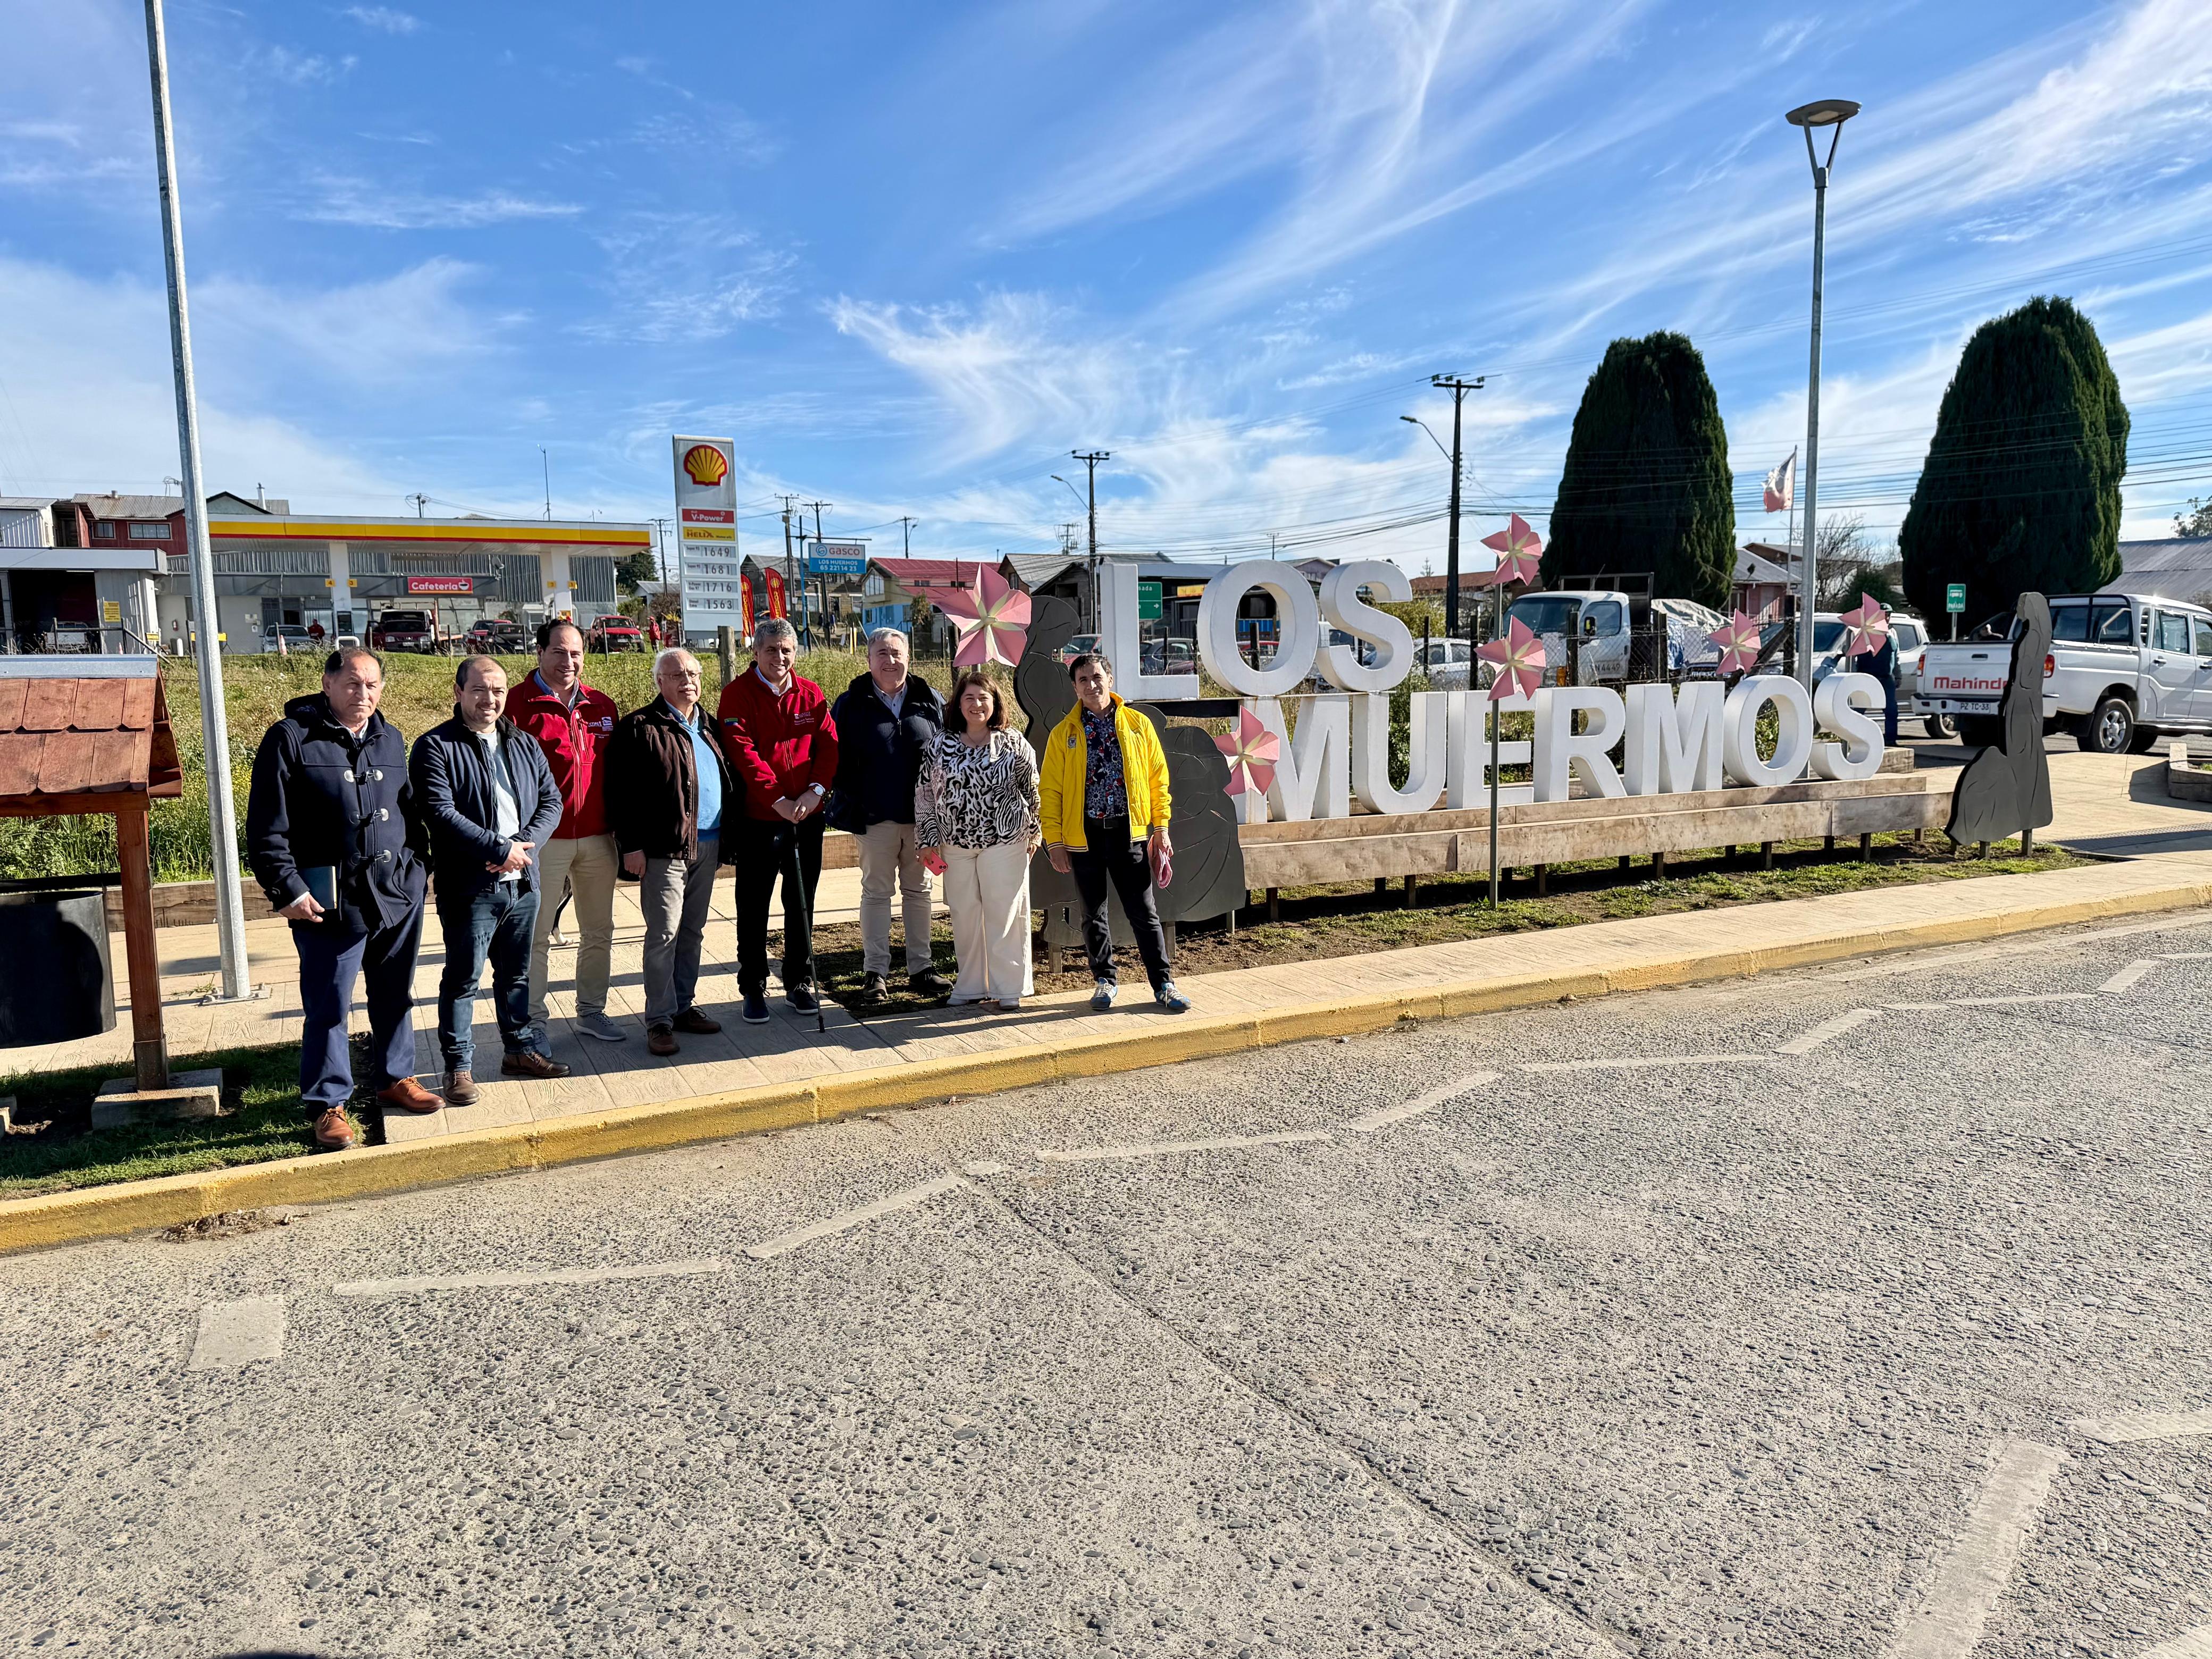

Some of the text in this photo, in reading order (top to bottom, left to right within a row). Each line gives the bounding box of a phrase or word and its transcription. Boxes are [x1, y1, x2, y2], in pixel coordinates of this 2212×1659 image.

[686, 530, 714, 538] HELIX
[705, 547, 730, 557] 1649
[705, 564, 730, 574] 1681
[412, 582, 458, 590] Cafeteria
[706, 582, 732, 592] 1716
[707, 599, 732, 609] 1563
[1100, 559, 1414, 702] LOS
[1230, 672, 1886, 824] MUERMOS
